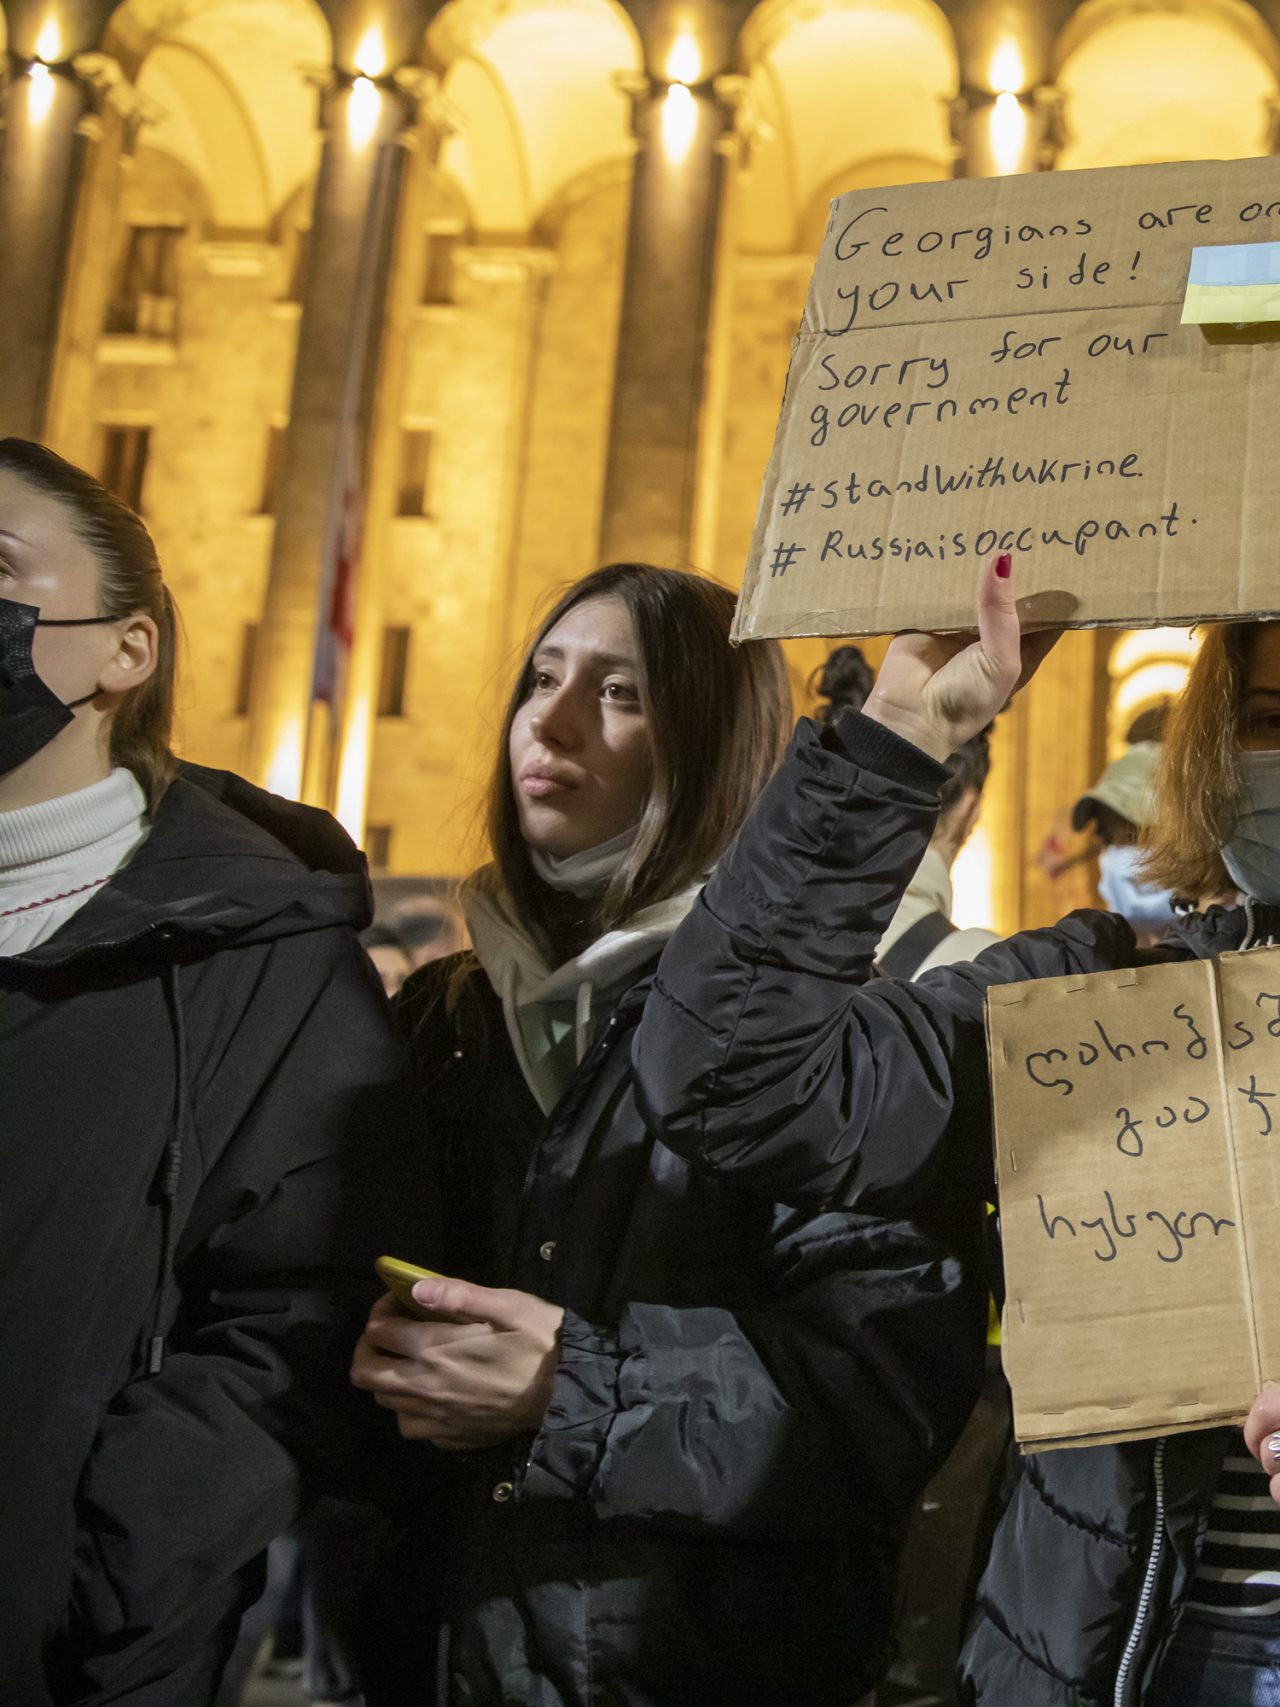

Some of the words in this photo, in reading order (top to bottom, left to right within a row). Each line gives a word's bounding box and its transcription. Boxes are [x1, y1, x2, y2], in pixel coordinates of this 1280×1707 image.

[833, 206, 1093, 261] Georgians
[1137, 203, 1214, 231] are
[824, 278, 970, 337] your
[817, 353, 950, 391] Sorry
[989, 330, 1063, 363] for
[1086, 332, 1170, 358] our
[809, 368, 1073, 448] government
